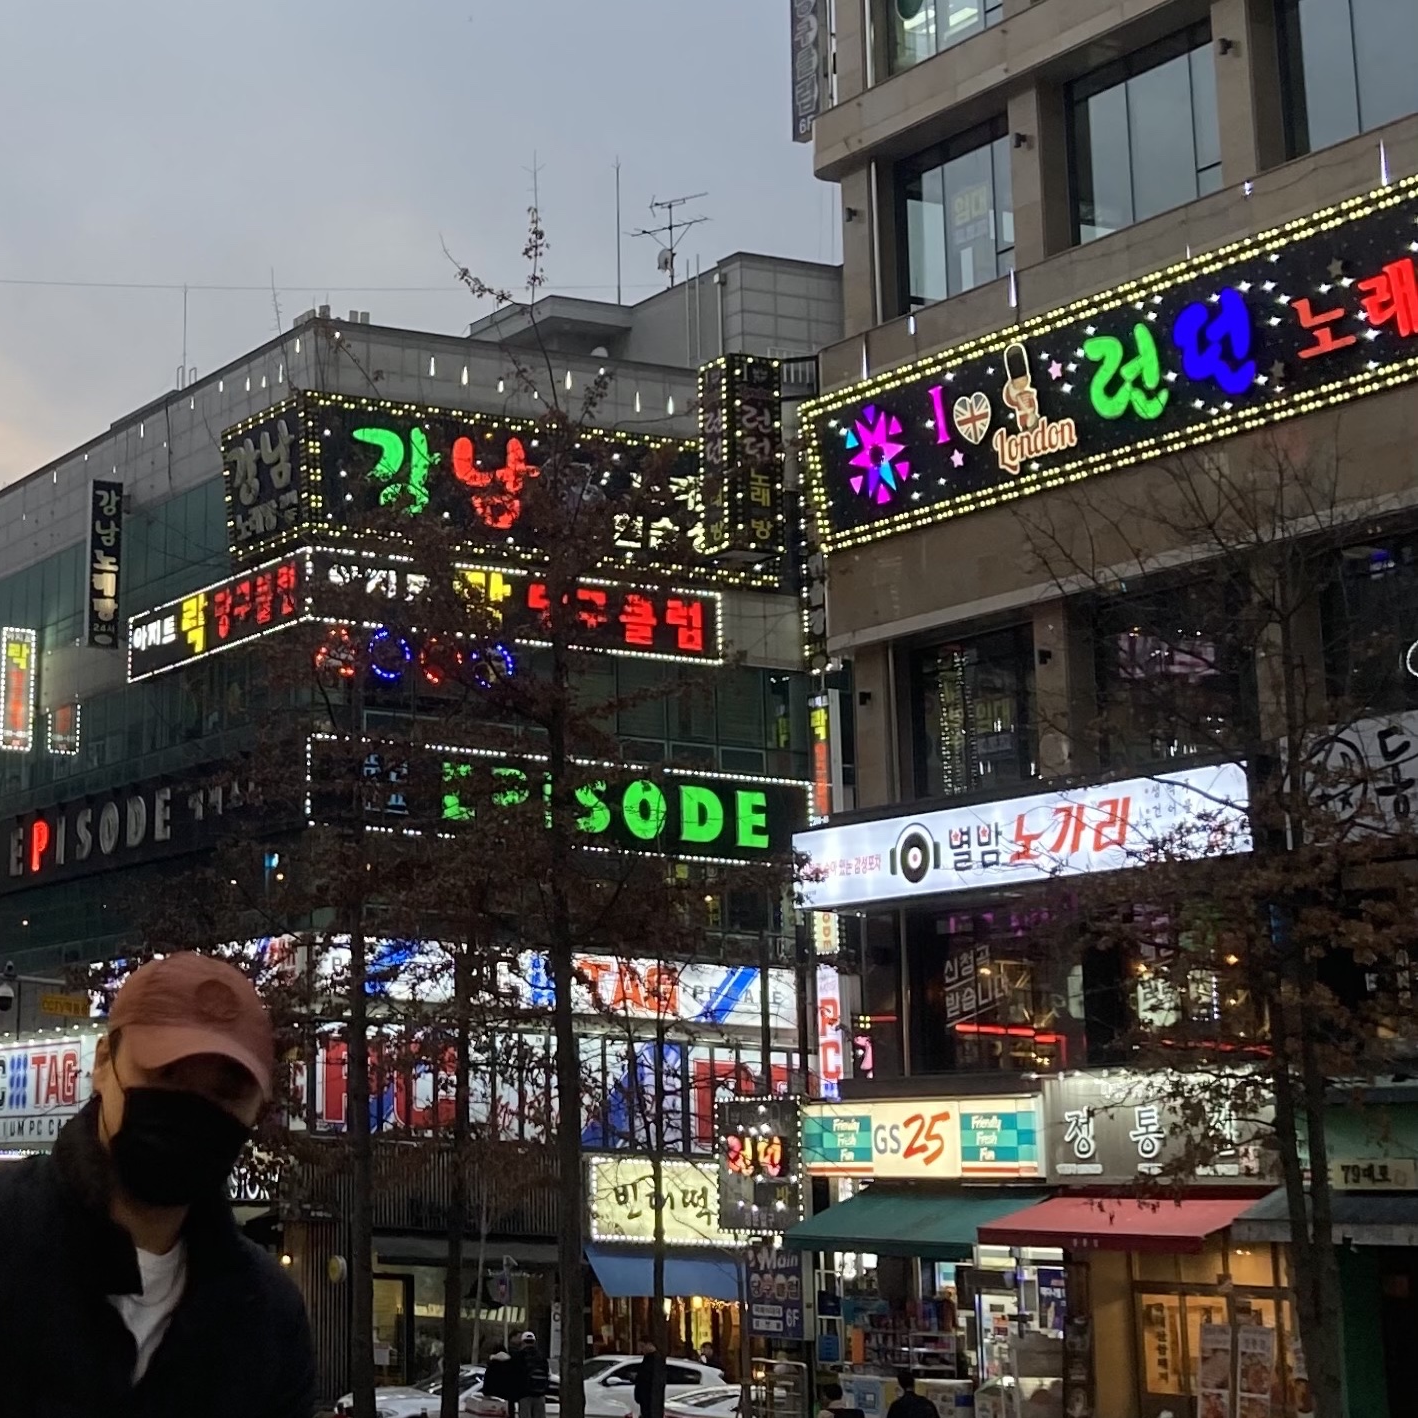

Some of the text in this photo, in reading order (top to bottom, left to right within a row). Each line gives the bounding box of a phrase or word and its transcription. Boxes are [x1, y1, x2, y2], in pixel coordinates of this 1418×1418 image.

[928, 385, 948, 445] I
[992, 417, 1077, 475] London
[1084, 287, 1256, 420] 런던
[230, 419, 294, 505] 강남
[133, 614, 176, 651] 아지트
[9, 786, 171, 877] EPISODE
[1009, 796, 1131, 866] 노가리
[31, 1051, 77, 1108] TAG
[28, 1120, 43, 1135] PC
[874, 1111, 951, 1166] GS25
[971, 1115, 1002, 1131] Friendly
[976, 1132, 998, 1146] Fresh
[613, 1184, 713, 1226] 빈대떡
[785, 1308, 800, 1327] 6F
